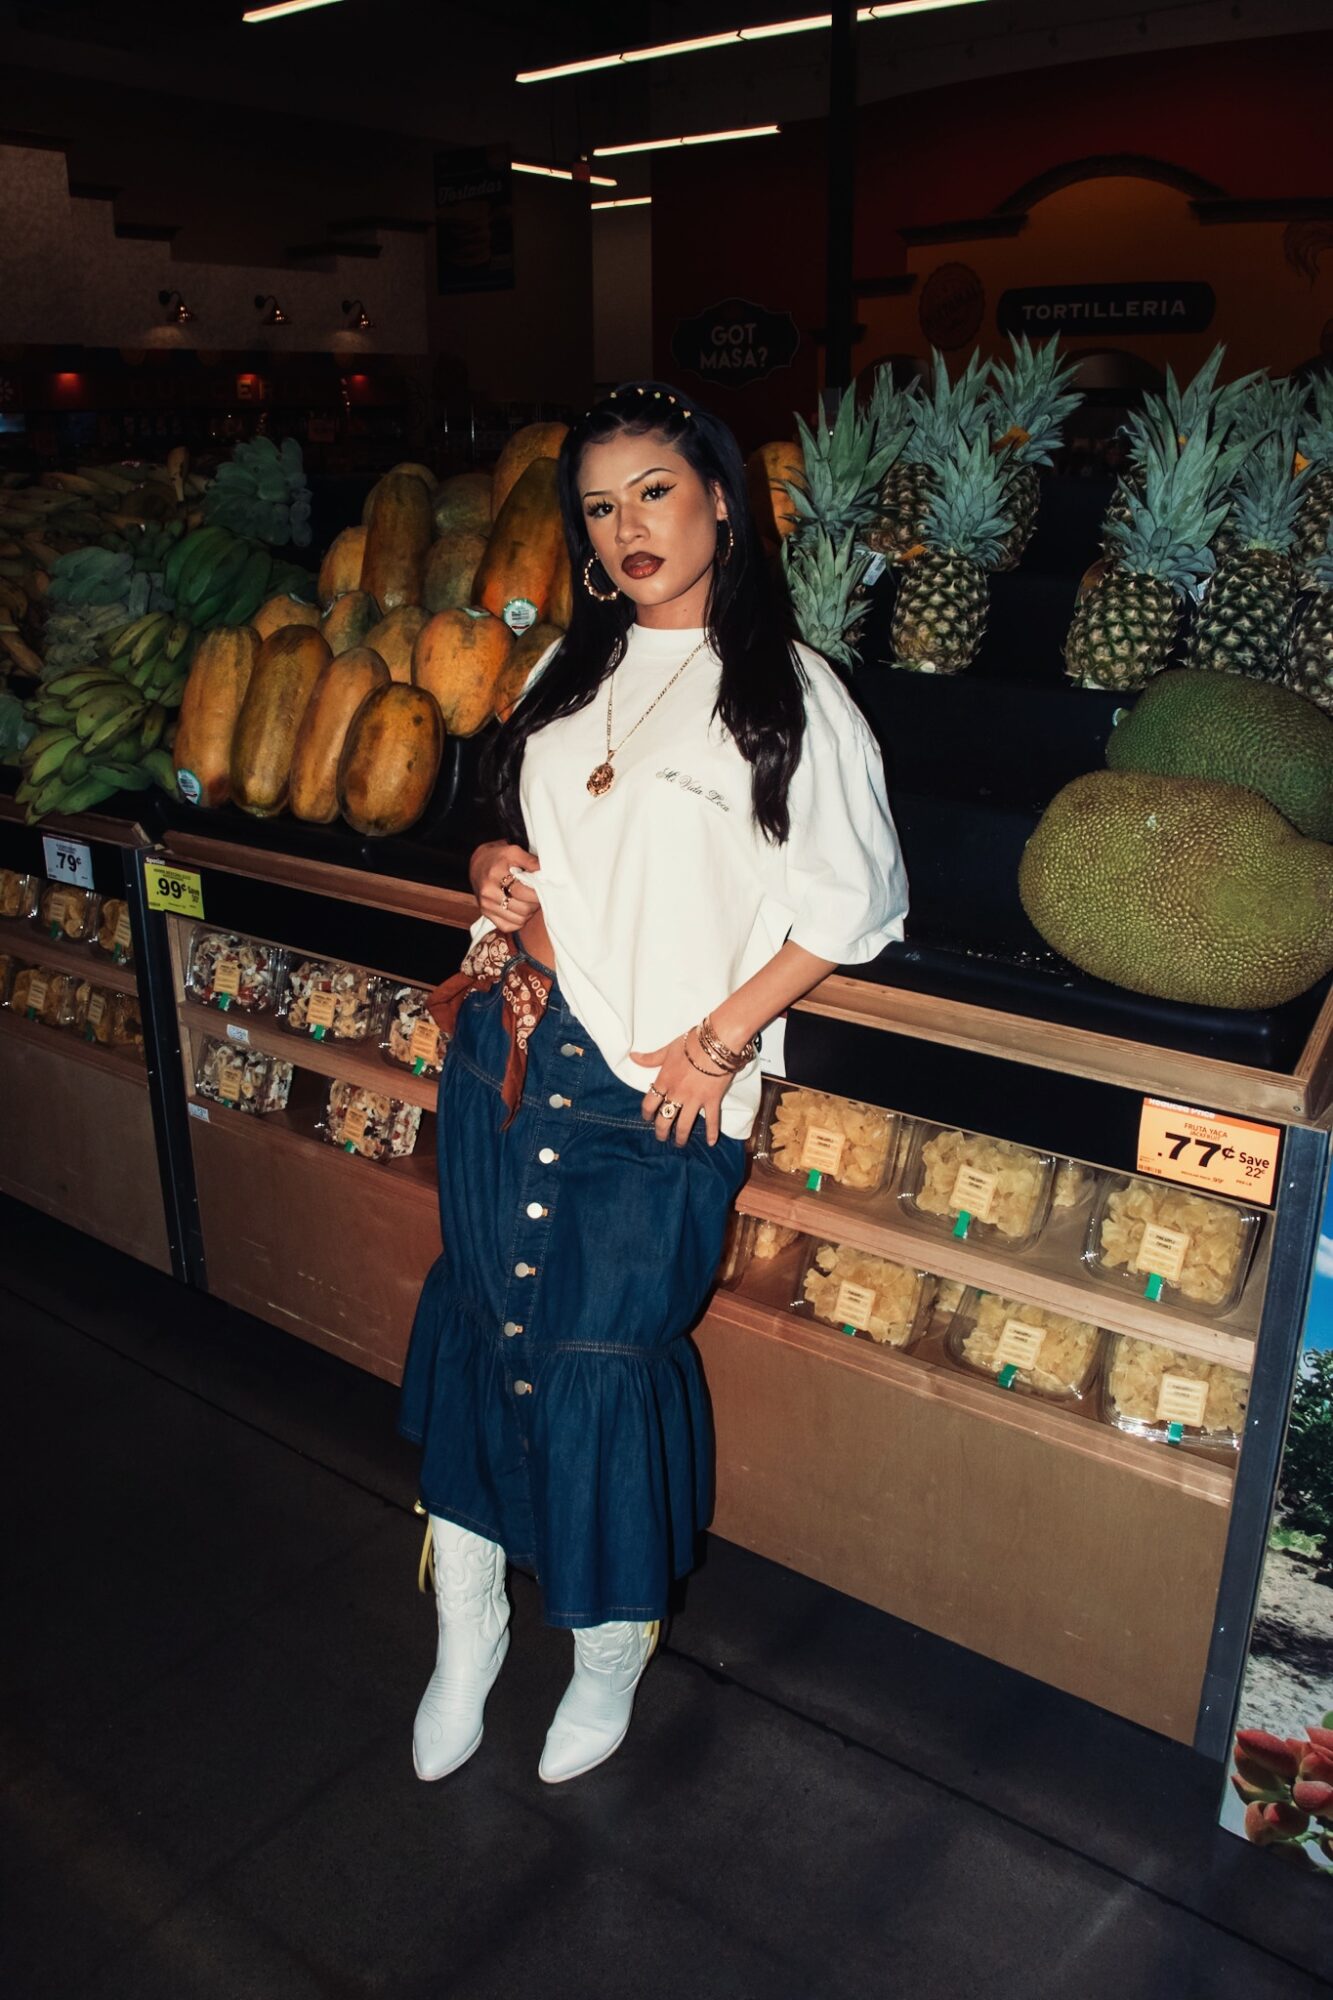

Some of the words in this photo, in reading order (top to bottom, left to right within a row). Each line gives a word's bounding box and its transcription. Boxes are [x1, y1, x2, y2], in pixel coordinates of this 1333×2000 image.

[1021, 299, 1187, 321] TORTILLERIA
[711, 322, 757, 346] GOT
[700, 346, 768, 369] MASA?
[1183, 1122, 1207, 1134] FRUTA
[1209, 1128, 1228, 1138] YACA
[1238, 1151, 1270, 1169] Save
